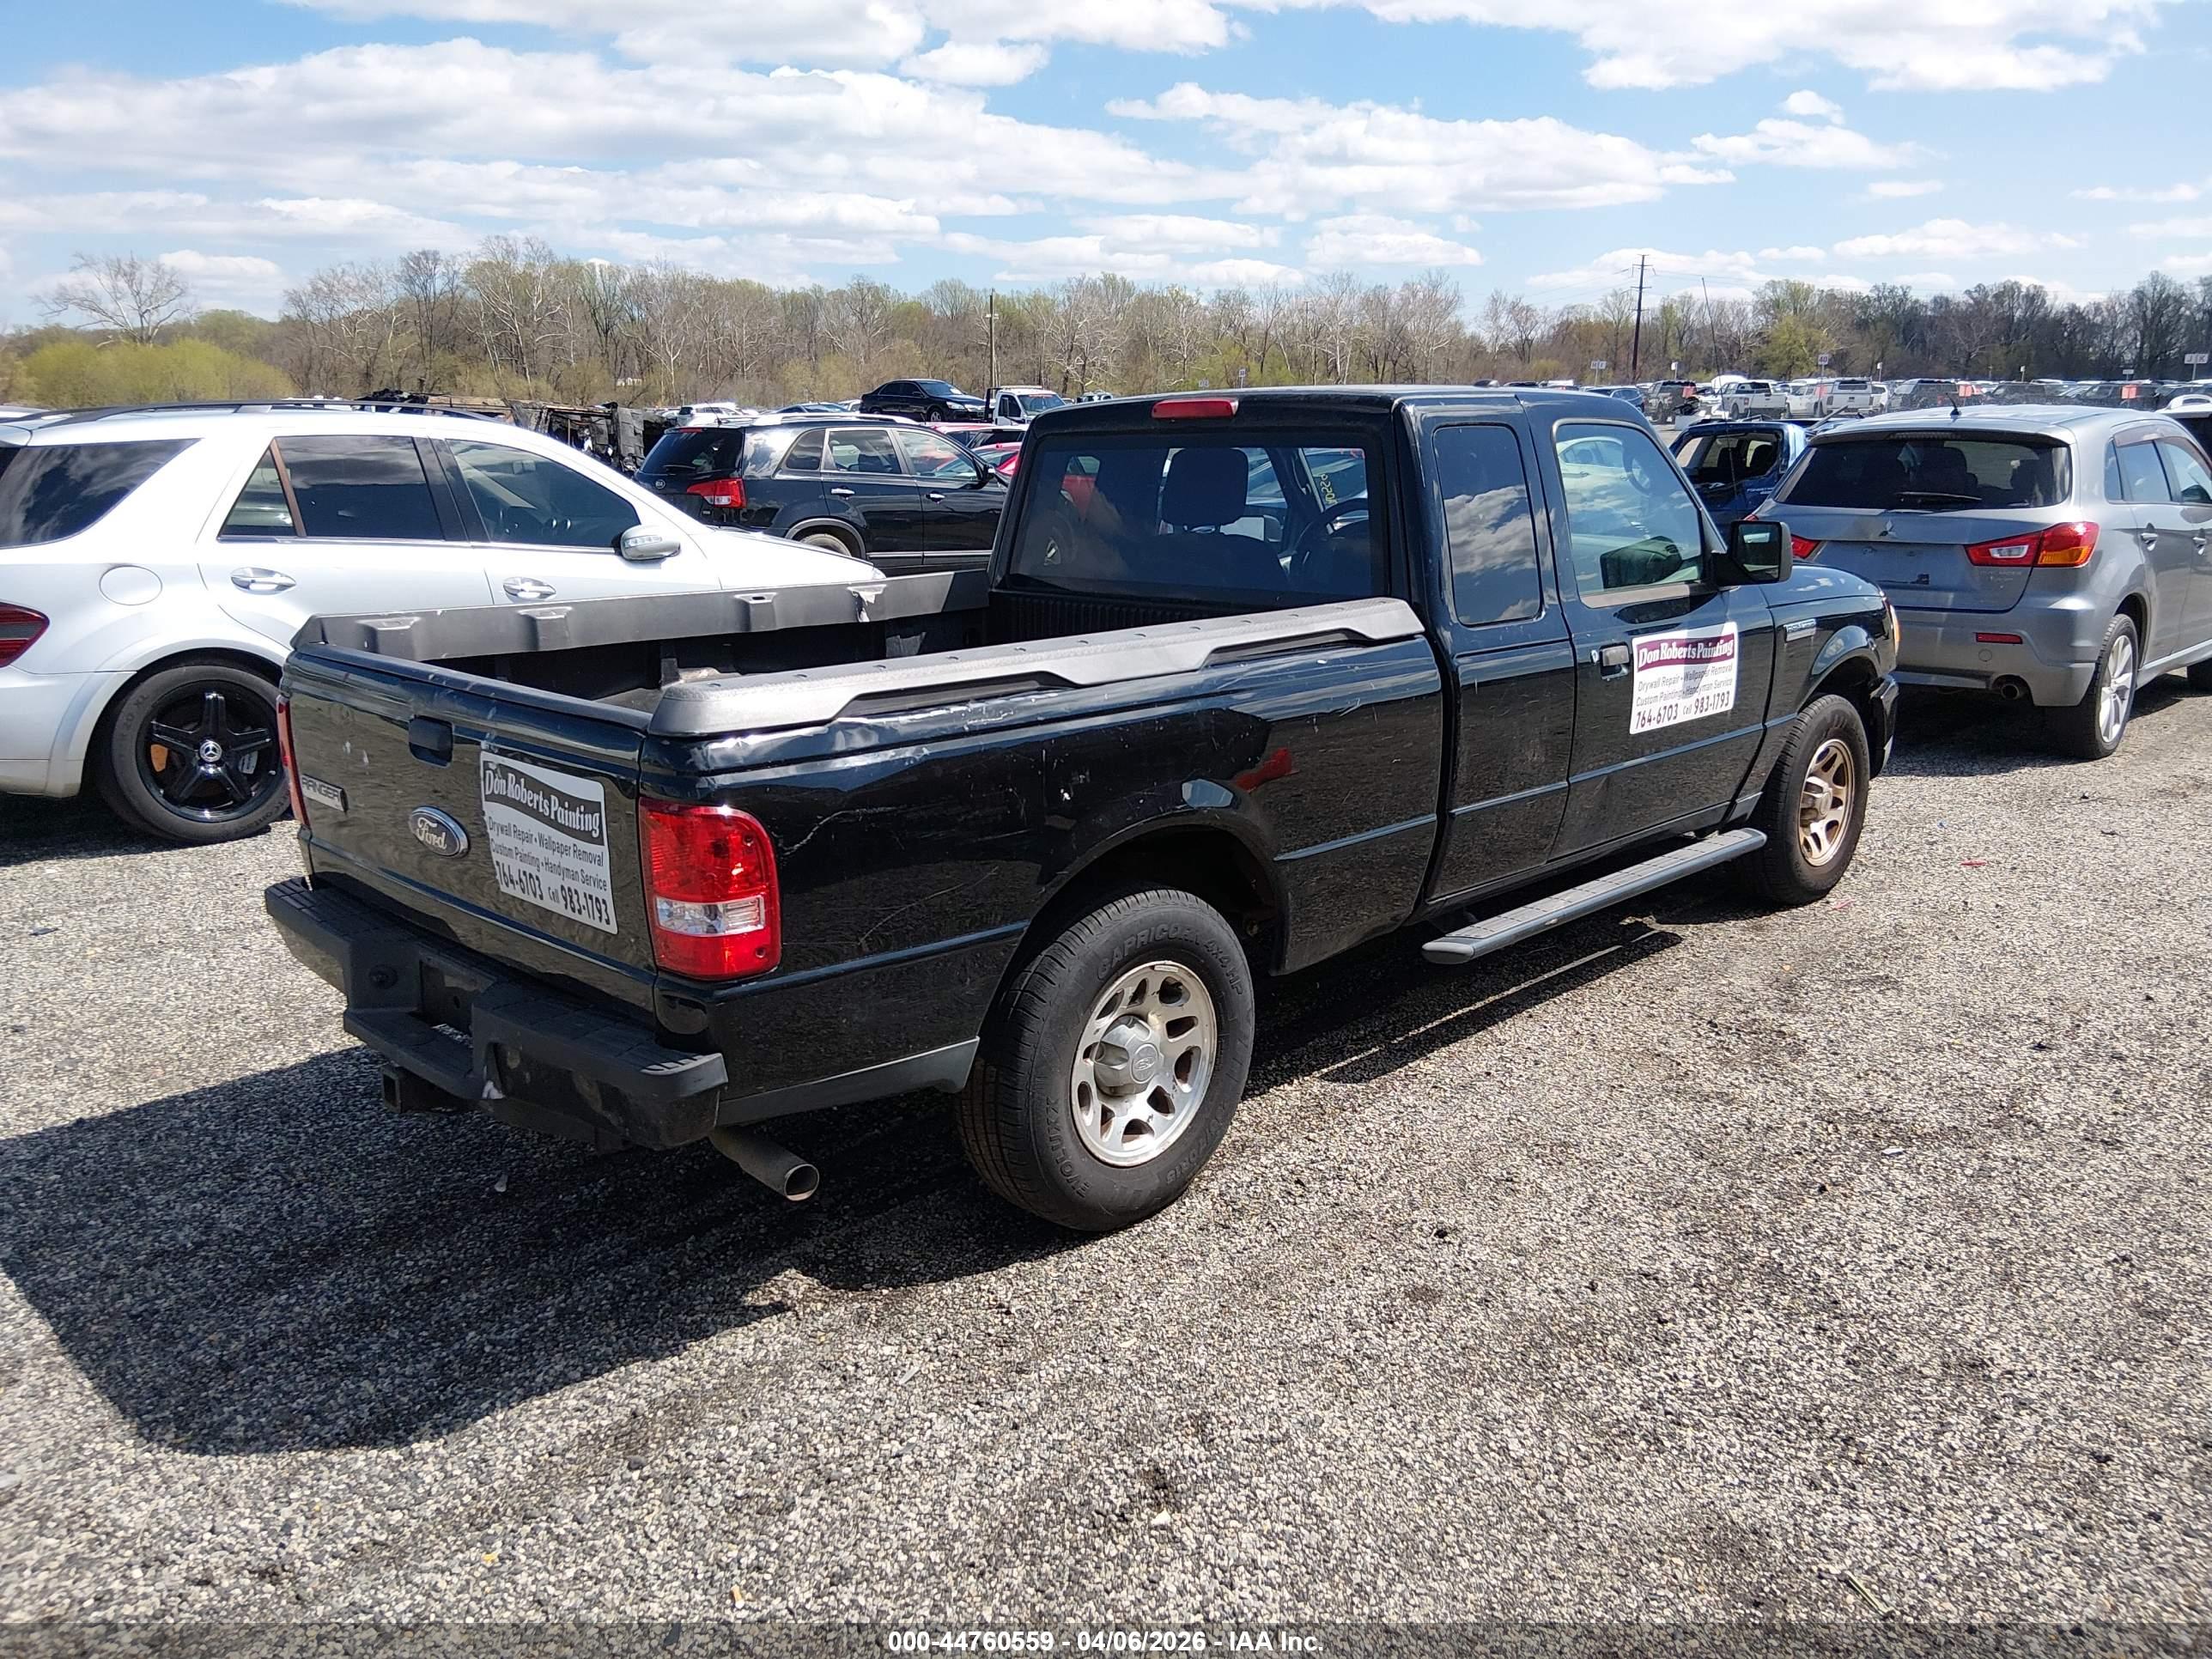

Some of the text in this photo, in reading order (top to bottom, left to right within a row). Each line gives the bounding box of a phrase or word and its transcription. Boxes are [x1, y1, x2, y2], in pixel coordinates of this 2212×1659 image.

[1638, 638, 1734, 669] Don Roberts Painting
[1636, 678, 1733, 707] Custom Painting Handyman Service
[1638, 662, 1733, 692] Drywall Repair Wallpaper Removal
[1636, 690, 1730, 729] 764-6703 Cell 983-1793
[301, 775, 341, 802] RANGER
[485, 769, 600, 838] Don Roberts Painting
[416, 817, 447, 849] Ford
[489, 817, 604, 866] Drywall Repair Wallpaper Removal
[490, 838, 607, 891] Custom Painting Handyman Service
[495, 860, 611, 926] 764-6703 Cell 983-1793
